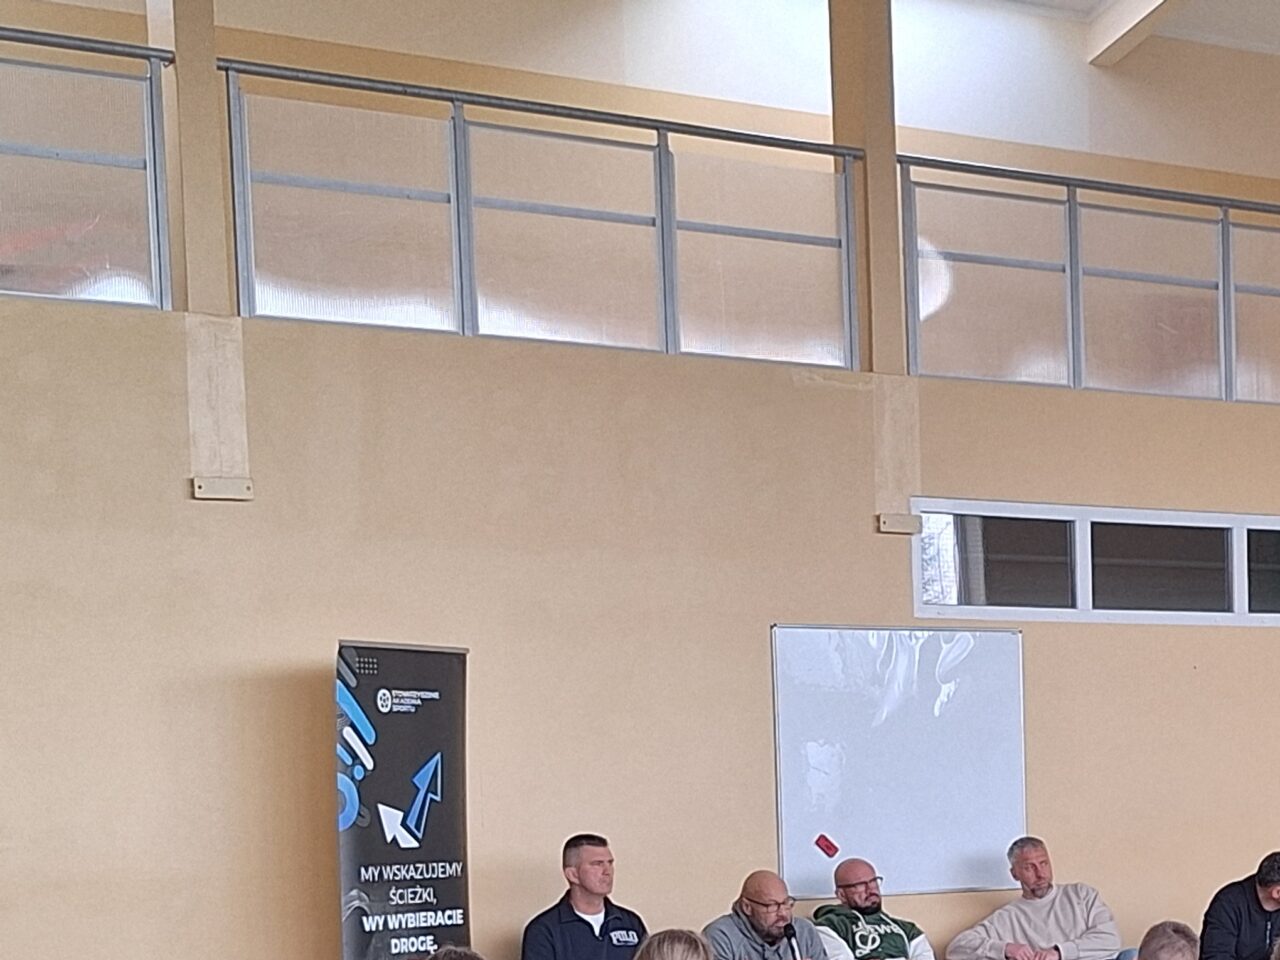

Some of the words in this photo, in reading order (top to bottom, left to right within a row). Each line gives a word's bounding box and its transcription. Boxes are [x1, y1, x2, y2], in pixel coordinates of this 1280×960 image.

[360, 866, 380, 882] MY
[382, 862, 463, 881] WSKAZUJEMY
[388, 885, 437, 905] ŚCIEŻKI,
[362, 915, 385, 932] WY
[387, 909, 464, 930] WYBIERACIE
